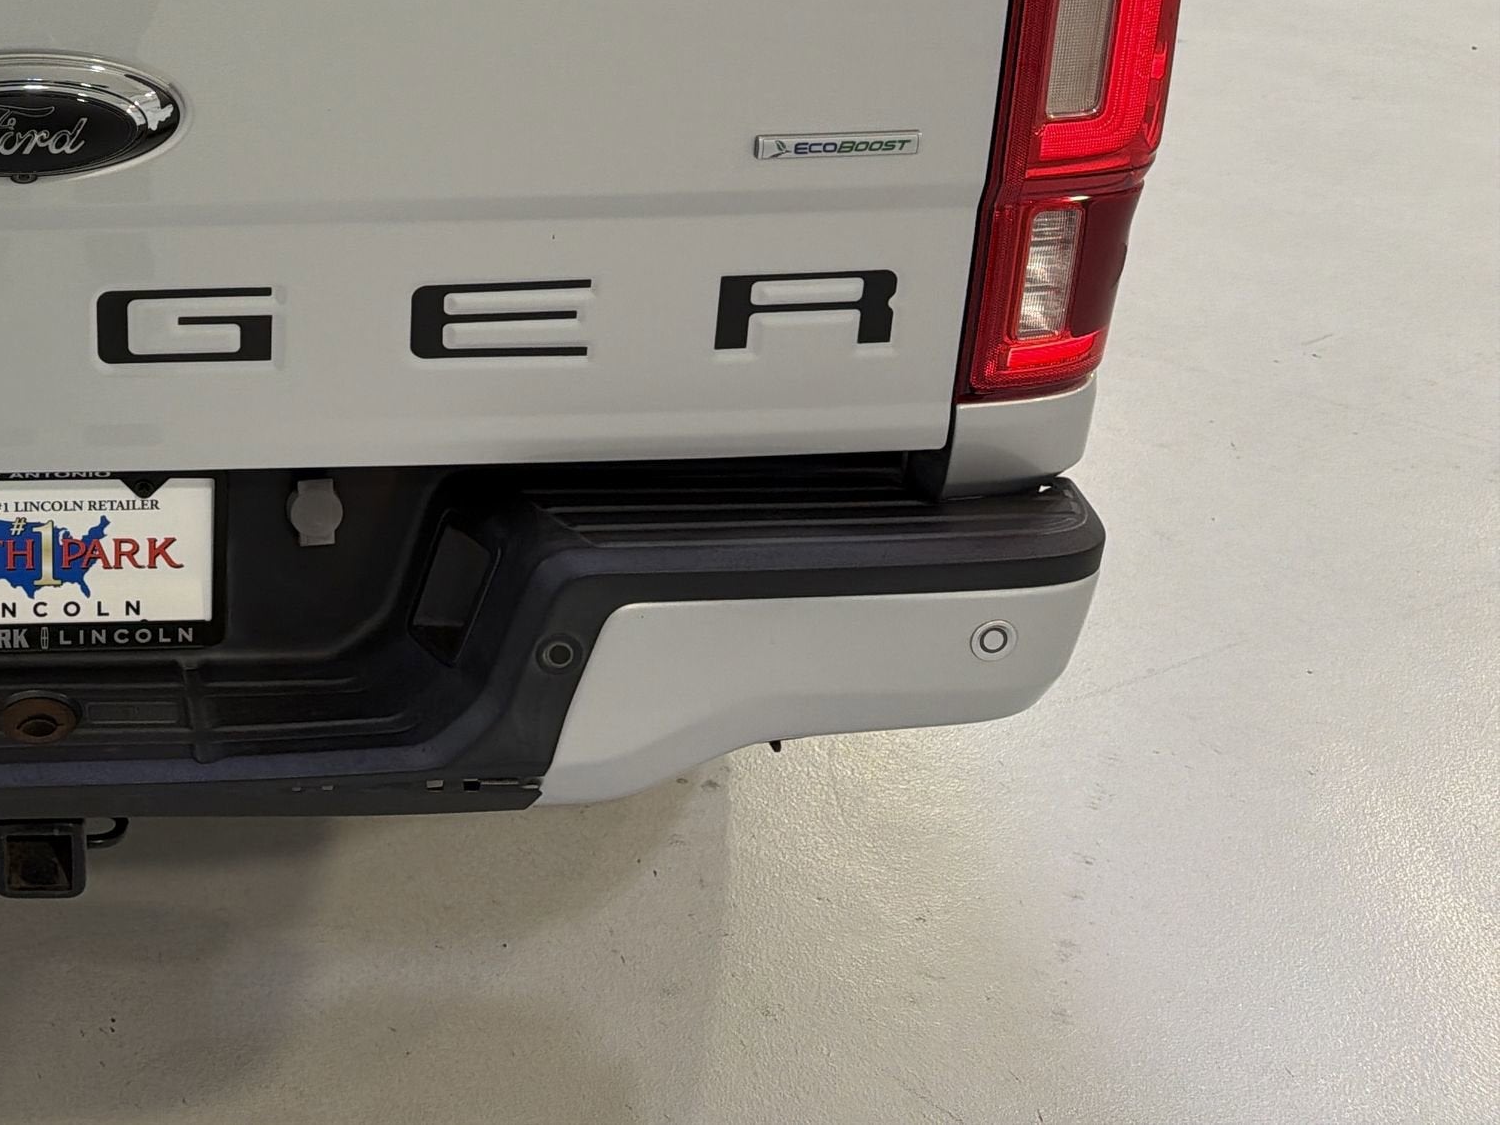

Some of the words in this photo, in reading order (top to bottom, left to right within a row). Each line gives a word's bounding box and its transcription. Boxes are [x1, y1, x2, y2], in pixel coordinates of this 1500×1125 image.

[793, 139, 912, 155] ECOBOOST
[8, 471, 111, 480] ANTONIO
[15, 500, 84, 513] LINCOLN
[88, 499, 161, 511] RETAILER
[61, 537, 185, 570] PARK
[59, 627, 194, 646] LINCOLN
